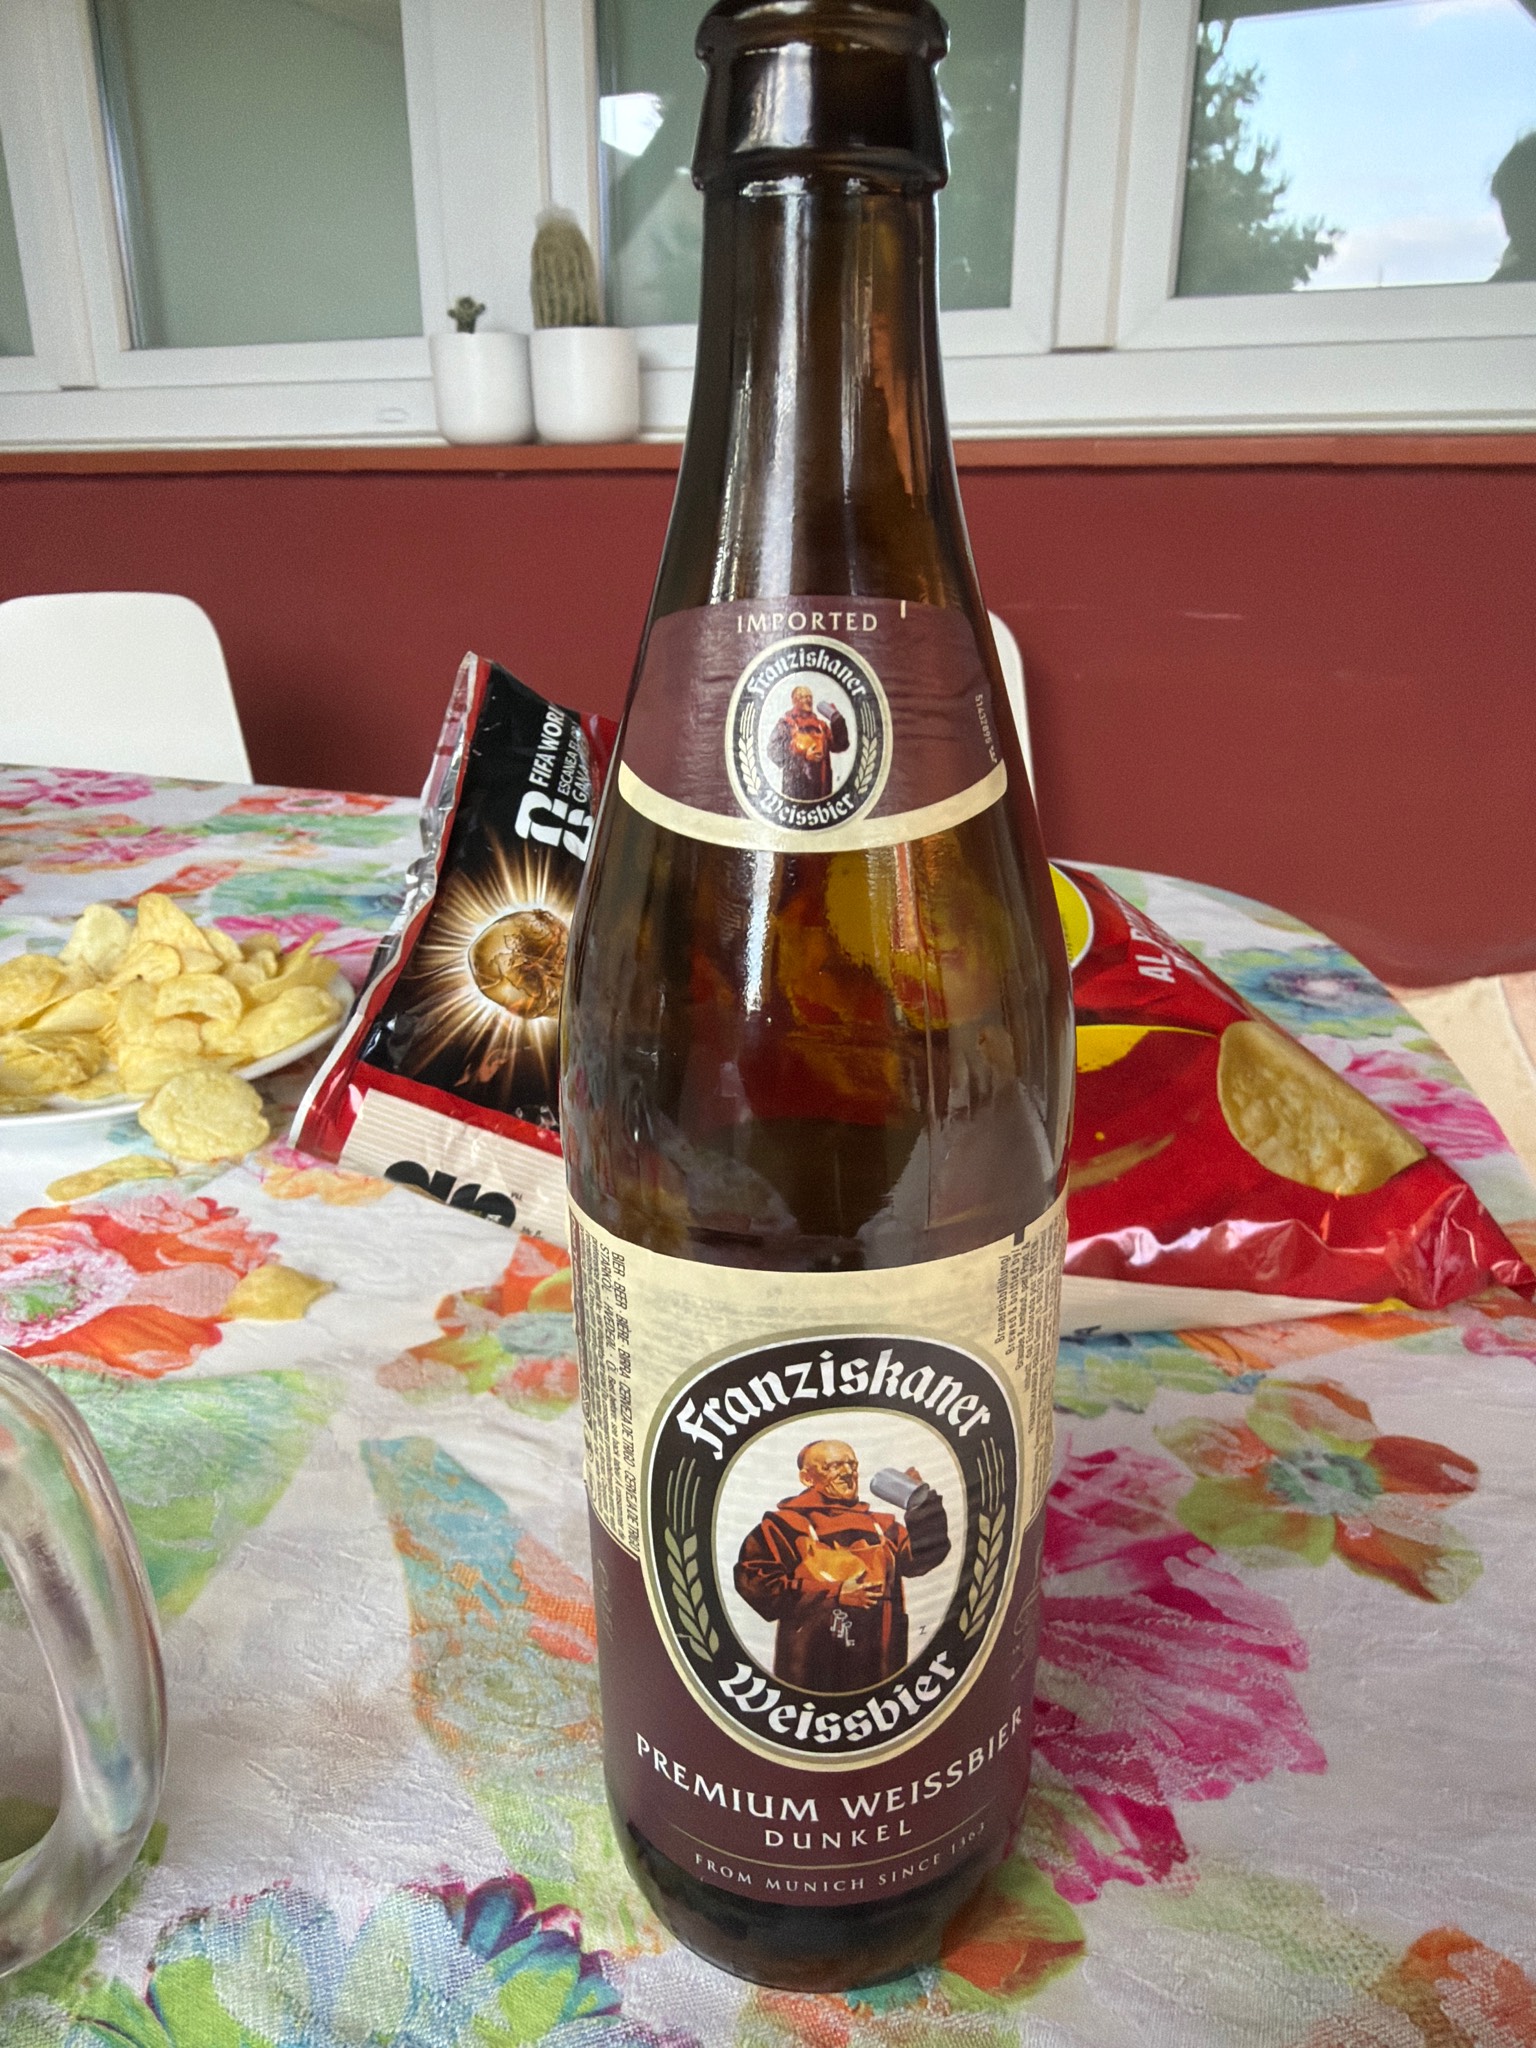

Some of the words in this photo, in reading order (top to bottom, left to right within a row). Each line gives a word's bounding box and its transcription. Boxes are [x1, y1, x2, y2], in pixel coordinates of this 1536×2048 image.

[737, 611, 878, 634] IMPORTED
[746, 647, 867, 699] Franziskaner
[528, 752, 557, 788] FIFA
[557, 751, 579, 797] ESCANEA
[761, 790, 856, 828] Weissbier
[1134, 954, 1177, 984] AL
[611, 1251, 626, 1278] BIER
[614, 1281, 628, 1311] BEER
[1005, 1316, 1017, 1356] Brewed
[618, 1348, 632, 1379] BIRRA
[619, 1381, 634, 1424] CERVEZA
[675, 1348, 991, 1461] Franziskaner
[622, 1422, 634, 1439] DE
[623, 1438, 636, 1468] TRIGO
[717, 1649, 961, 1744] Weissbier
[635, 1731, 820, 1823] PREMIUM
[840, 1704, 1023, 1821] WEISSBIER
[765, 1819, 912, 1850] DUNKEL
[694, 1852, 753, 1885] FROM
[765, 1877, 865, 1893] MUNICH
[878, 1852, 941, 1886] SINCE
